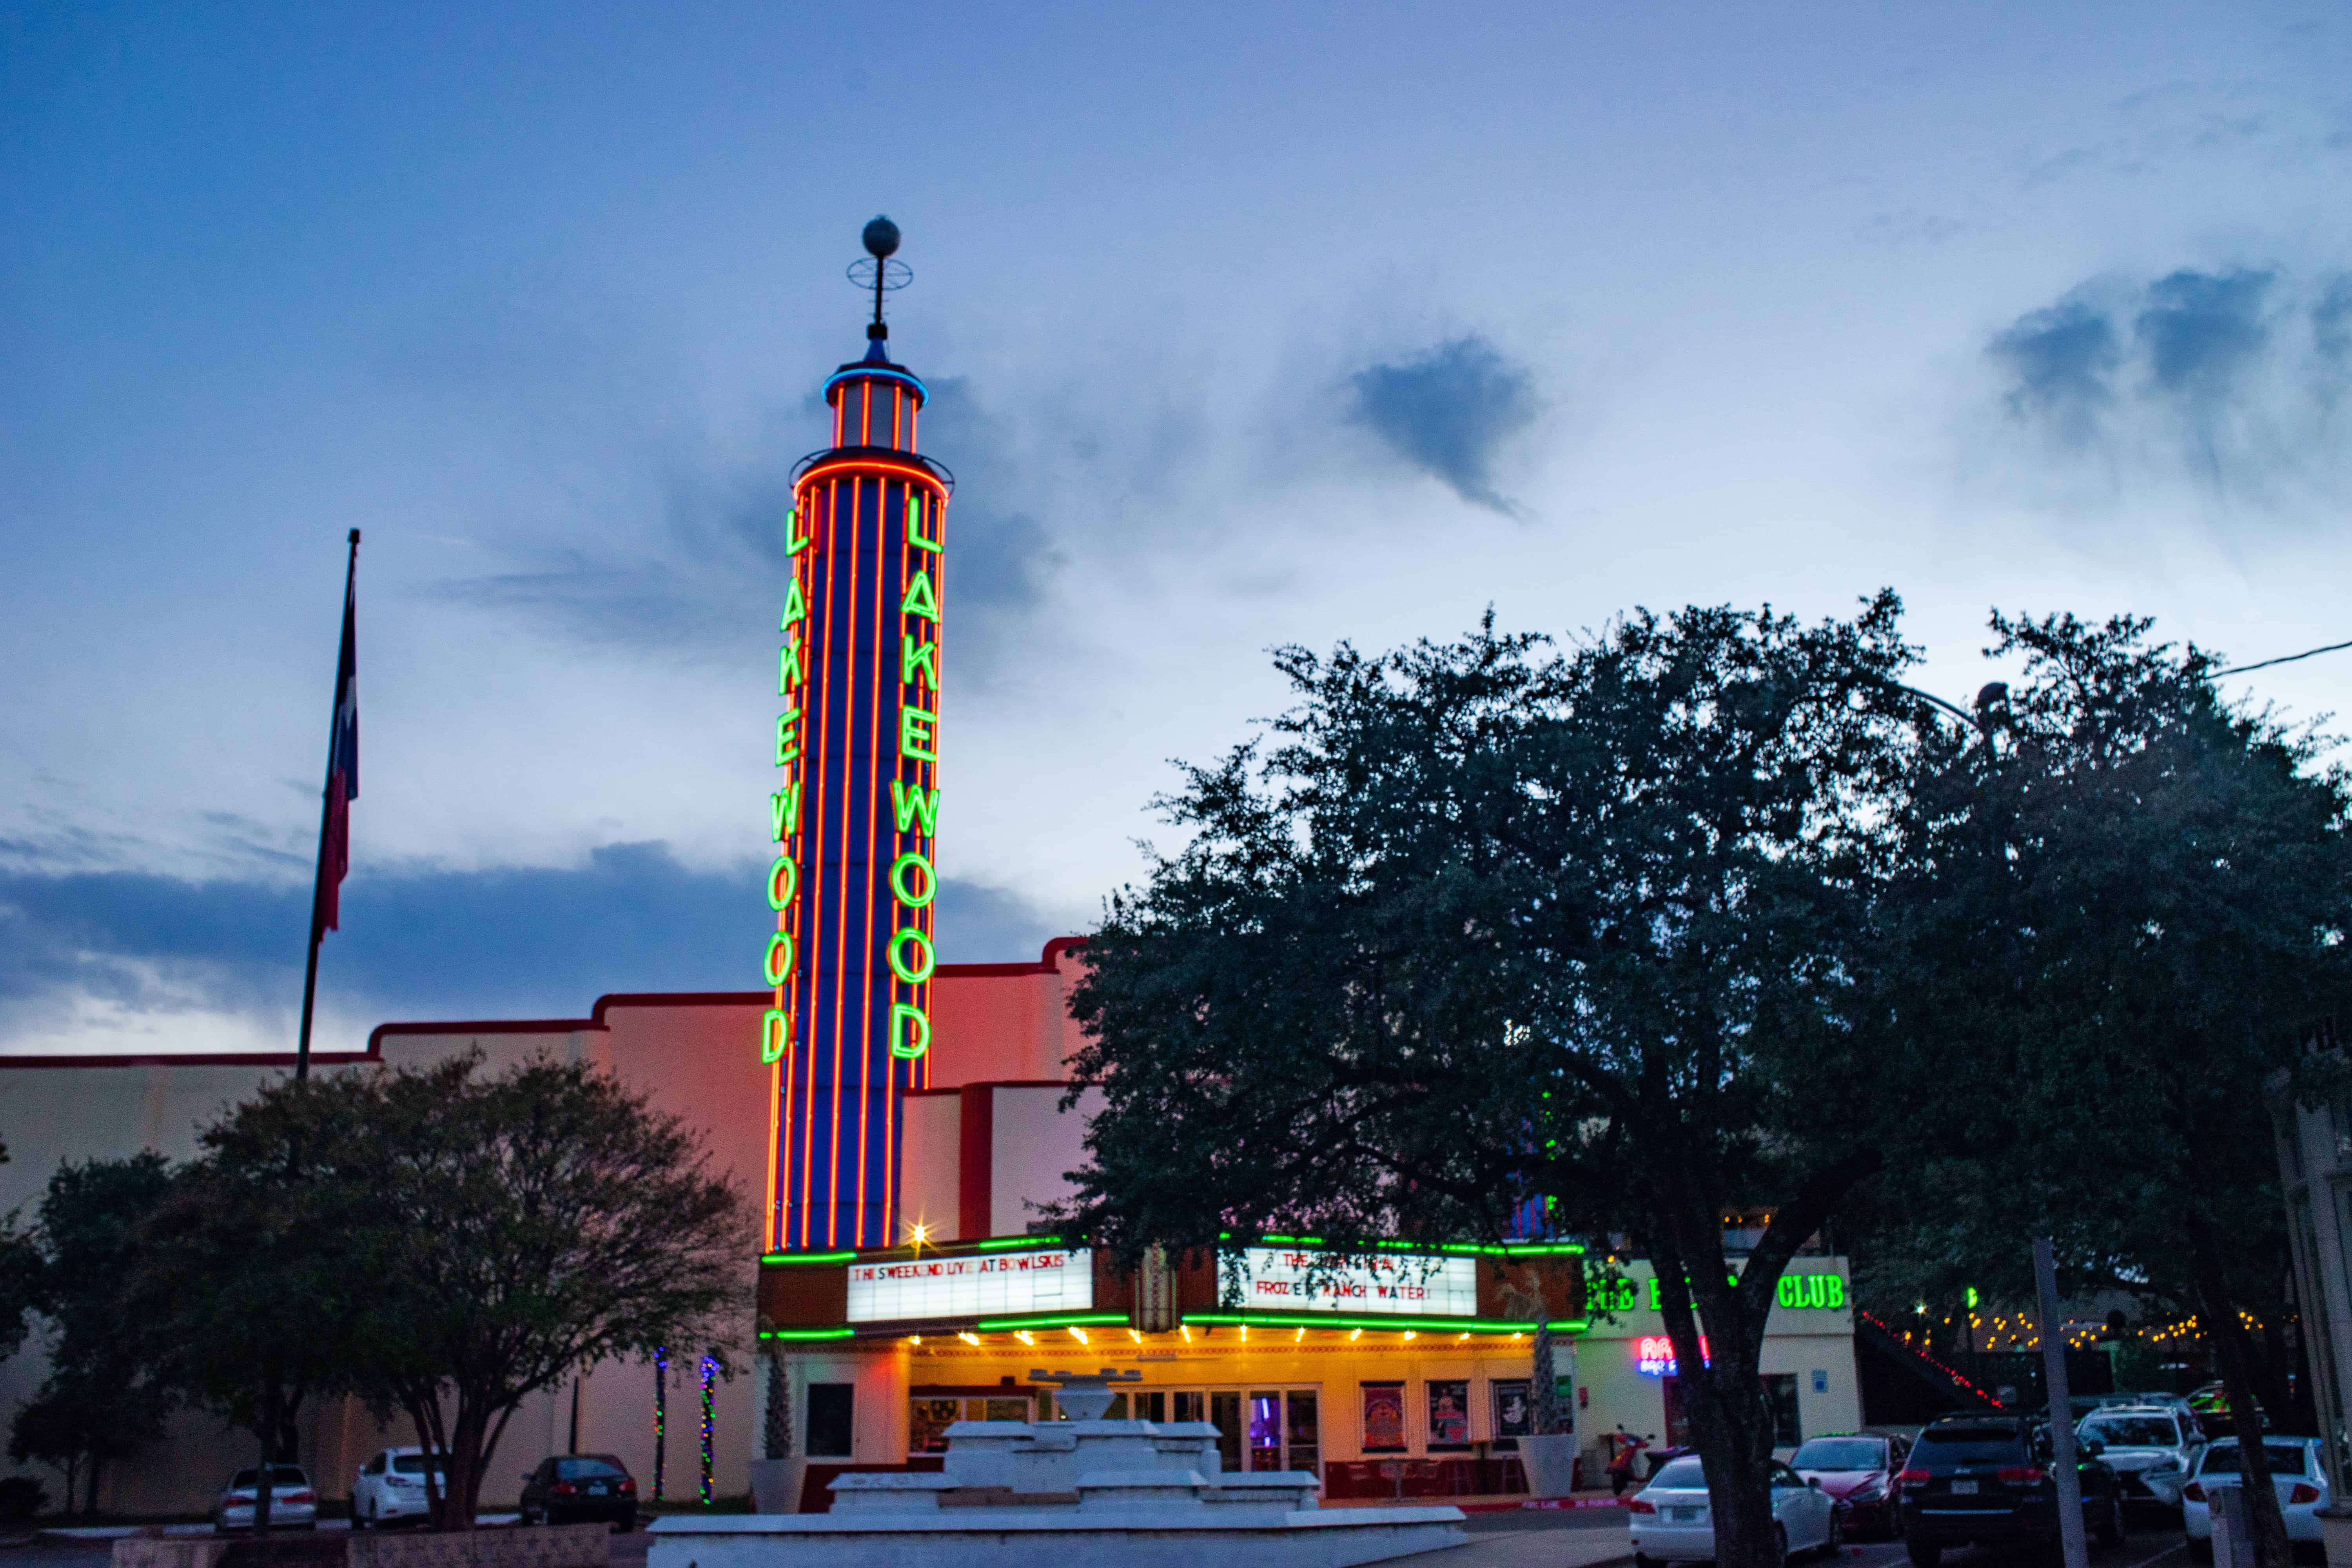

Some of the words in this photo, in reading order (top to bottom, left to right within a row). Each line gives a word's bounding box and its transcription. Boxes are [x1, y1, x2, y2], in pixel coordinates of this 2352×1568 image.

[762, 510, 809, 1064] LAKEWOOD
[889, 497, 943, 1059] LAKEWOOD
[947, 1259, 973, 1275] LIVE
[980, 1259, 996, 1272] AT
[1778, 1274, 1843, 1308] CLUB
